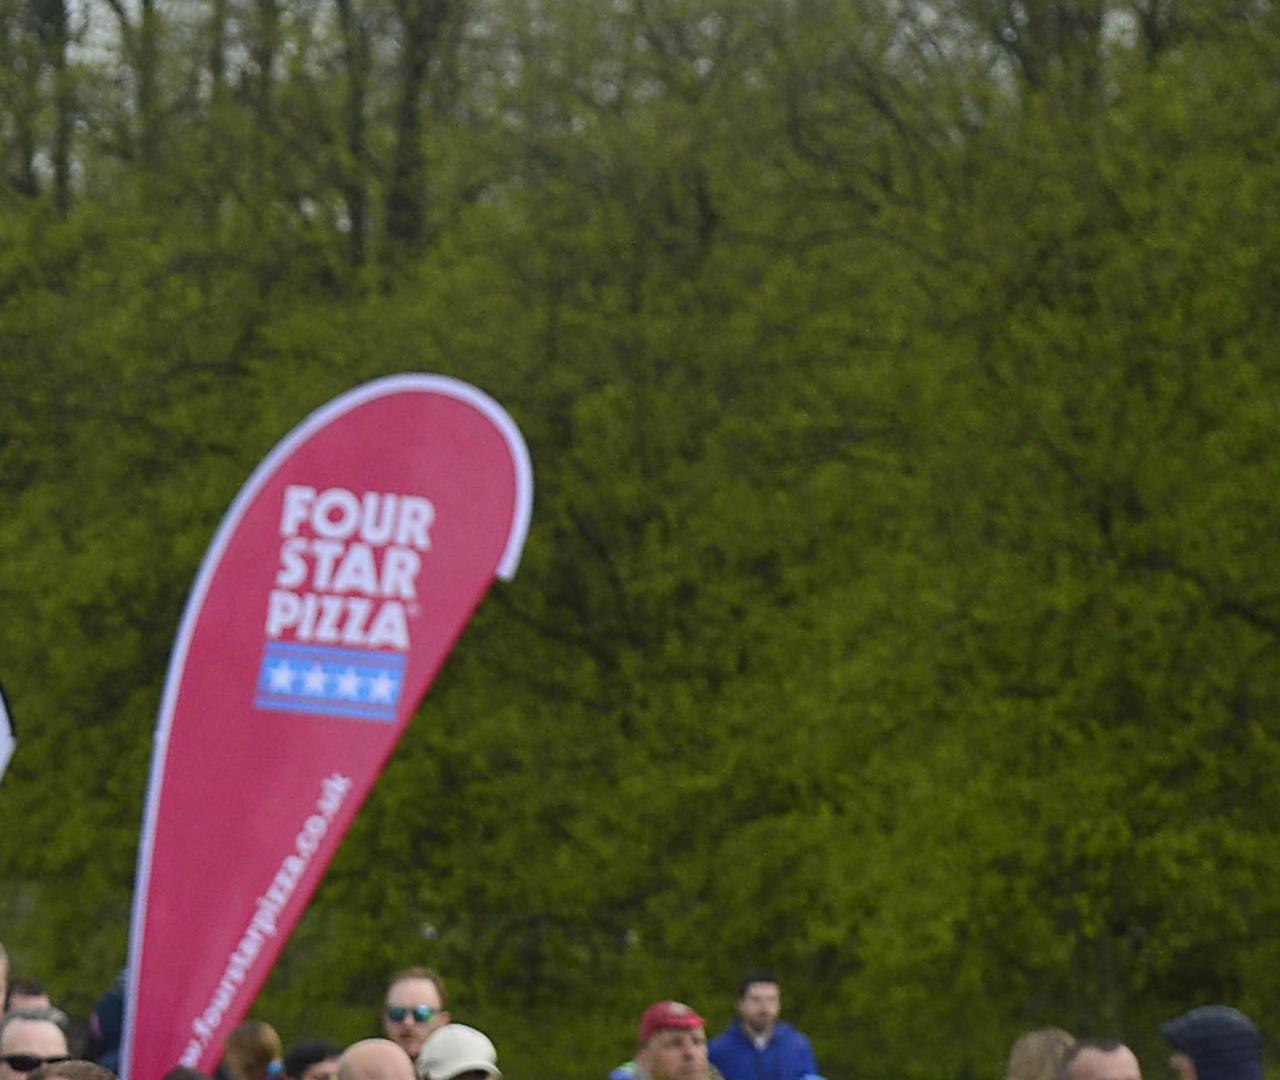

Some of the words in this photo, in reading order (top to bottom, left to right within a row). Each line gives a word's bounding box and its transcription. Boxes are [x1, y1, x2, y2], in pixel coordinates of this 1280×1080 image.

[281, 485, 435, 551] FOUR
[276, 536, 421, 600] STAR
[266, 589, 410, 648] PIZZA
